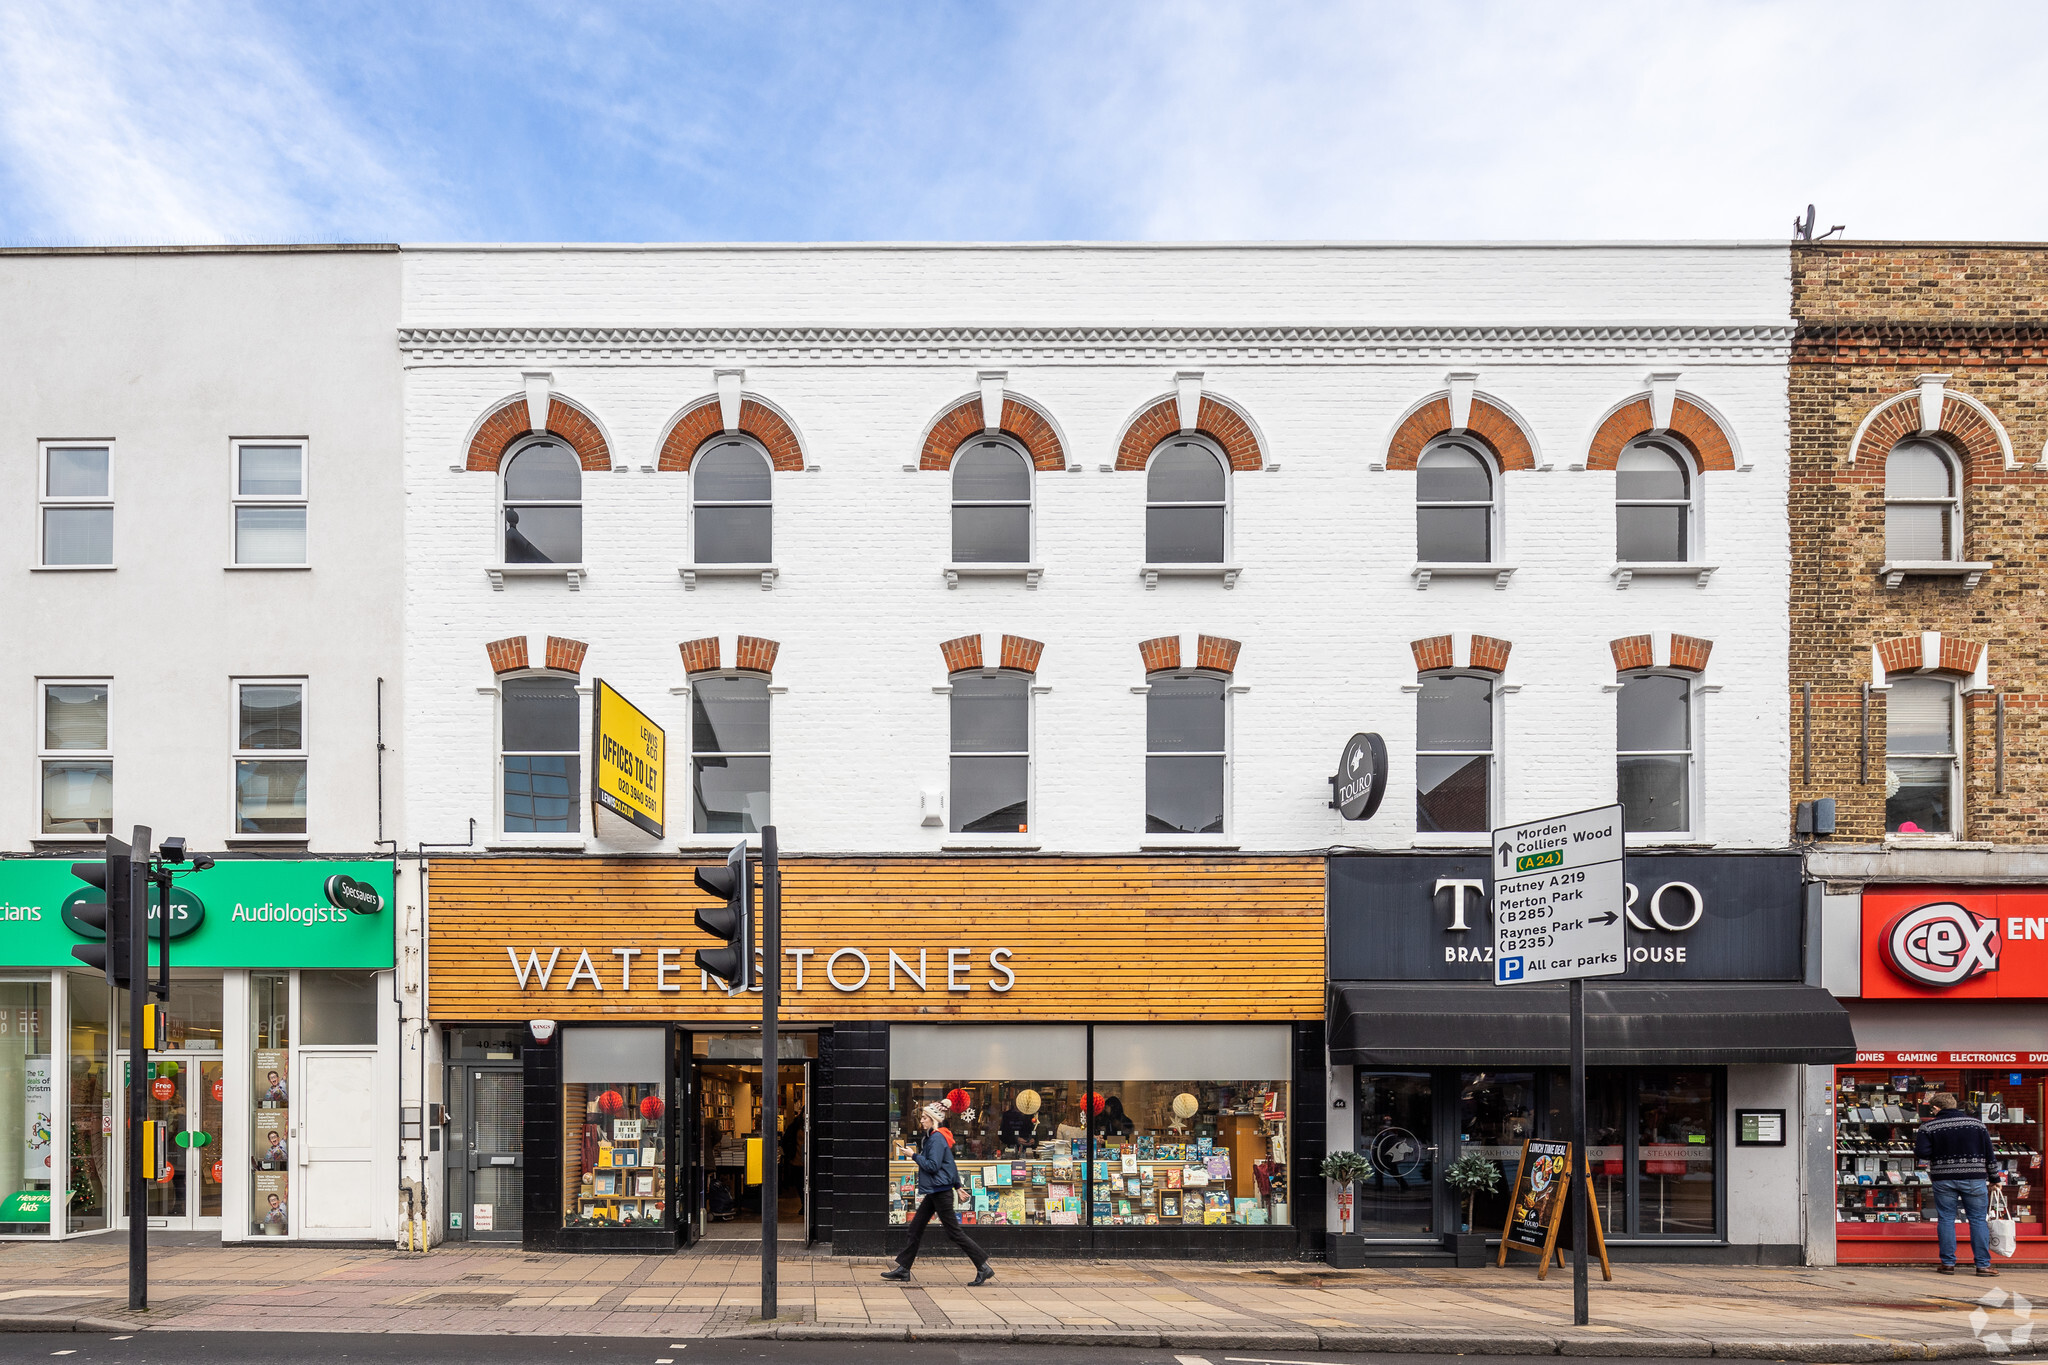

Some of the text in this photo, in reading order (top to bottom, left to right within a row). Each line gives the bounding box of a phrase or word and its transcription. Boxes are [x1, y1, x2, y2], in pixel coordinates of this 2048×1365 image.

[640, 725, 658, 749] LEWIS
[602, 733, 658, 793] OFFICES TO LET
[618, 777, 630, 796] 020
[1339, 772, 1372, 802] TOURO
[1516, 826, 1612, 854] Colliers Wood
[1517, 824, 1567, 841] Morden
[341, 881, 377, 905] Specsavers
[1500, 871, 1586, 895] Putney A219
[1500, 889, 1584, 911] Merton Park
[231, 902, 348, 926] Audiologists
[1499, 905, 1554, 924] (B285)
[1500, 919, 1584, 940] Raynes Park
[2007, 917, 2048, 940] EN
[1499, 935, 1554, 953] (B235)
[1505, 953, 1618, 978] P All car parks
[1897, 1053, 1938, 1062] GAMING
[1950, 1053, 2017, 1062] ELECTRONICS
[42, 1077, 50, 1085] of
[1528, 1142, 1567, 1156] LUNCH TIME DEAL
[18, 1203, 39, 1212] Aids
[1524, 1220, 1538, 1228] TOURO
